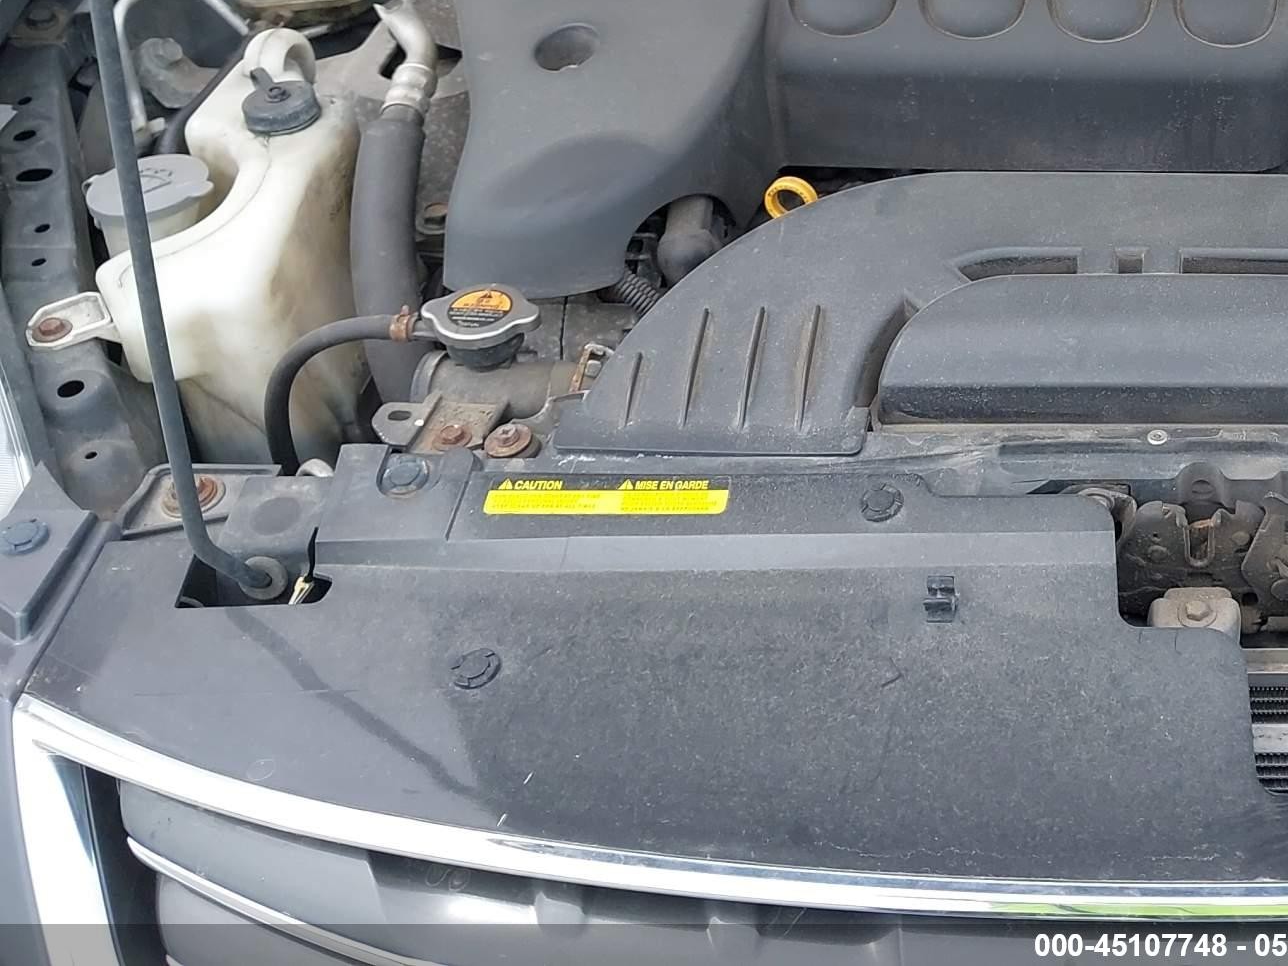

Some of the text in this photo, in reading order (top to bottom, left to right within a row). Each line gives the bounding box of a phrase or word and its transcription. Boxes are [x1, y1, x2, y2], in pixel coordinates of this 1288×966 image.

[514, 480, 563, 490] CAUTION
[635, 480, 709, 490] MISE EN GARDE
